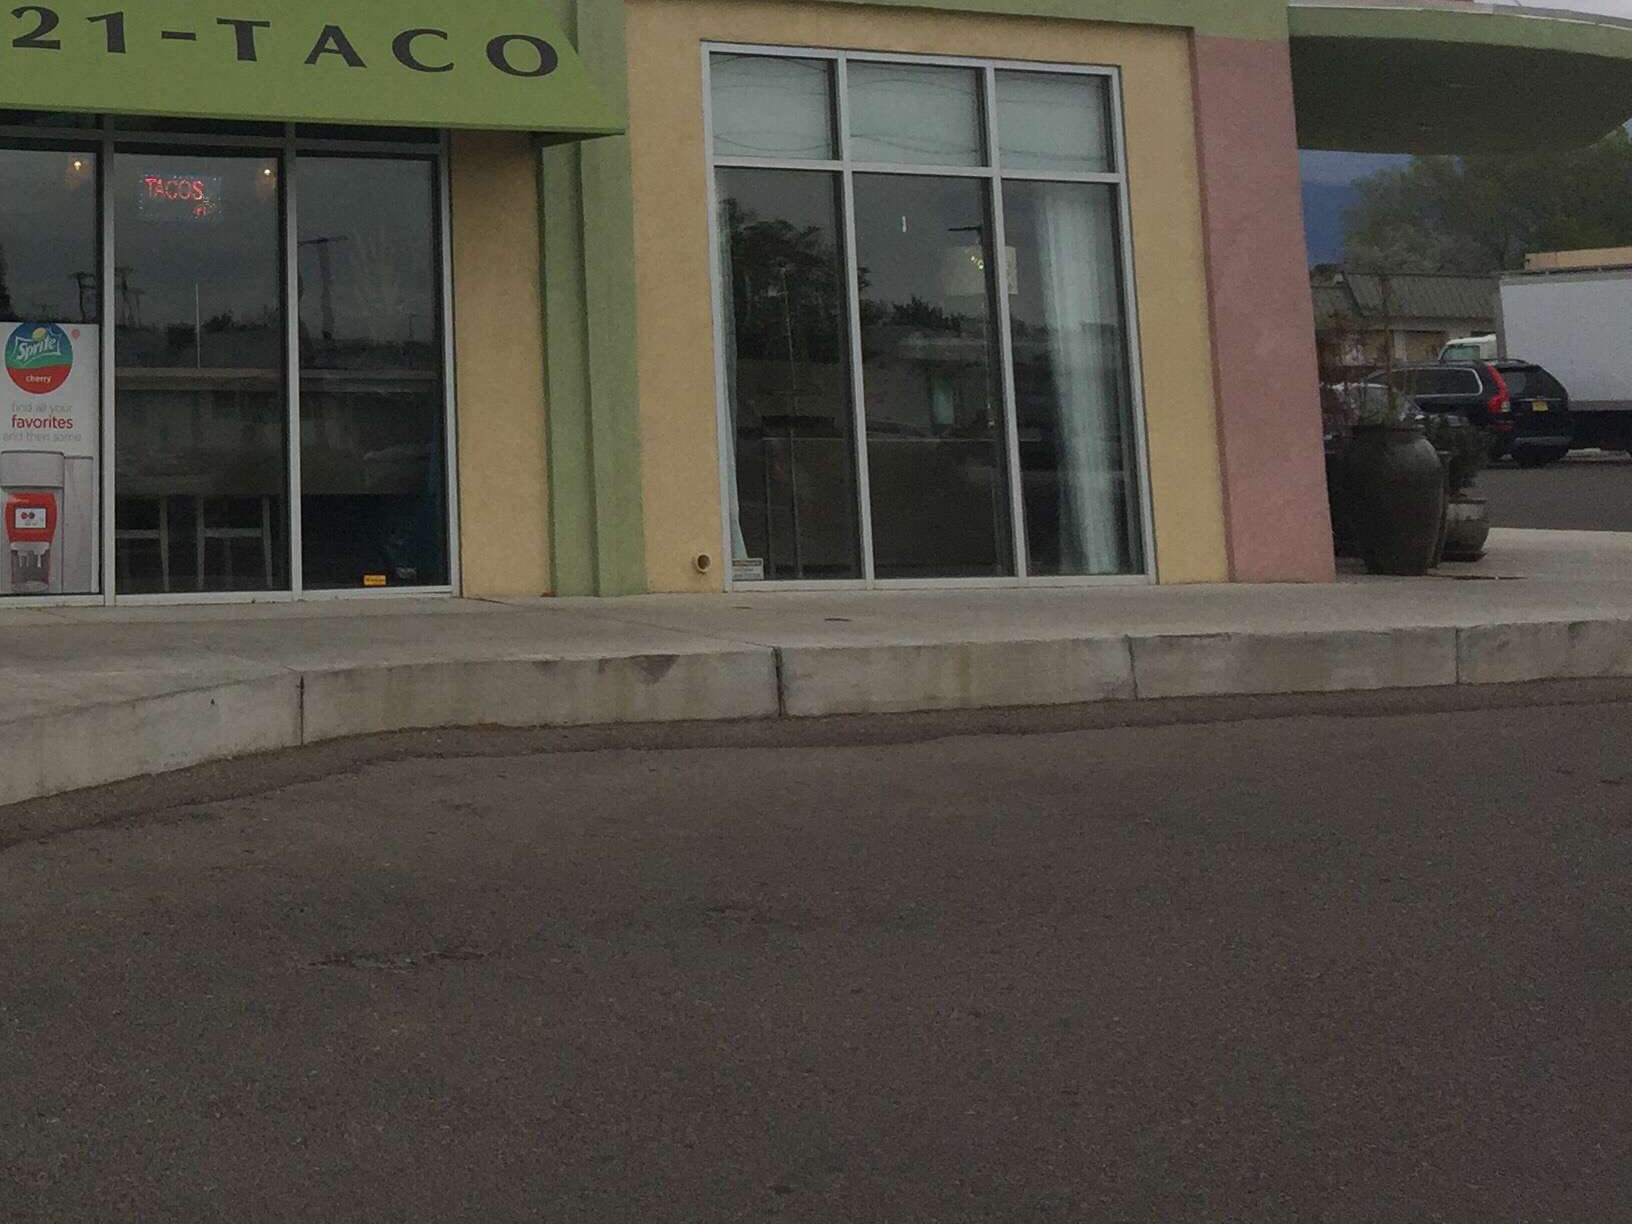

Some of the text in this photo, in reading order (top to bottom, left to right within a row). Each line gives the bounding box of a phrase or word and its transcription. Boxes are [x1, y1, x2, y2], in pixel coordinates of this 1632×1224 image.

[143, 175, 205, 201] TACOS
[16, 336, 57, 361] Sprite
[25, 375, 52, 385] cherry
[11, 414, 74, 429] favorites
